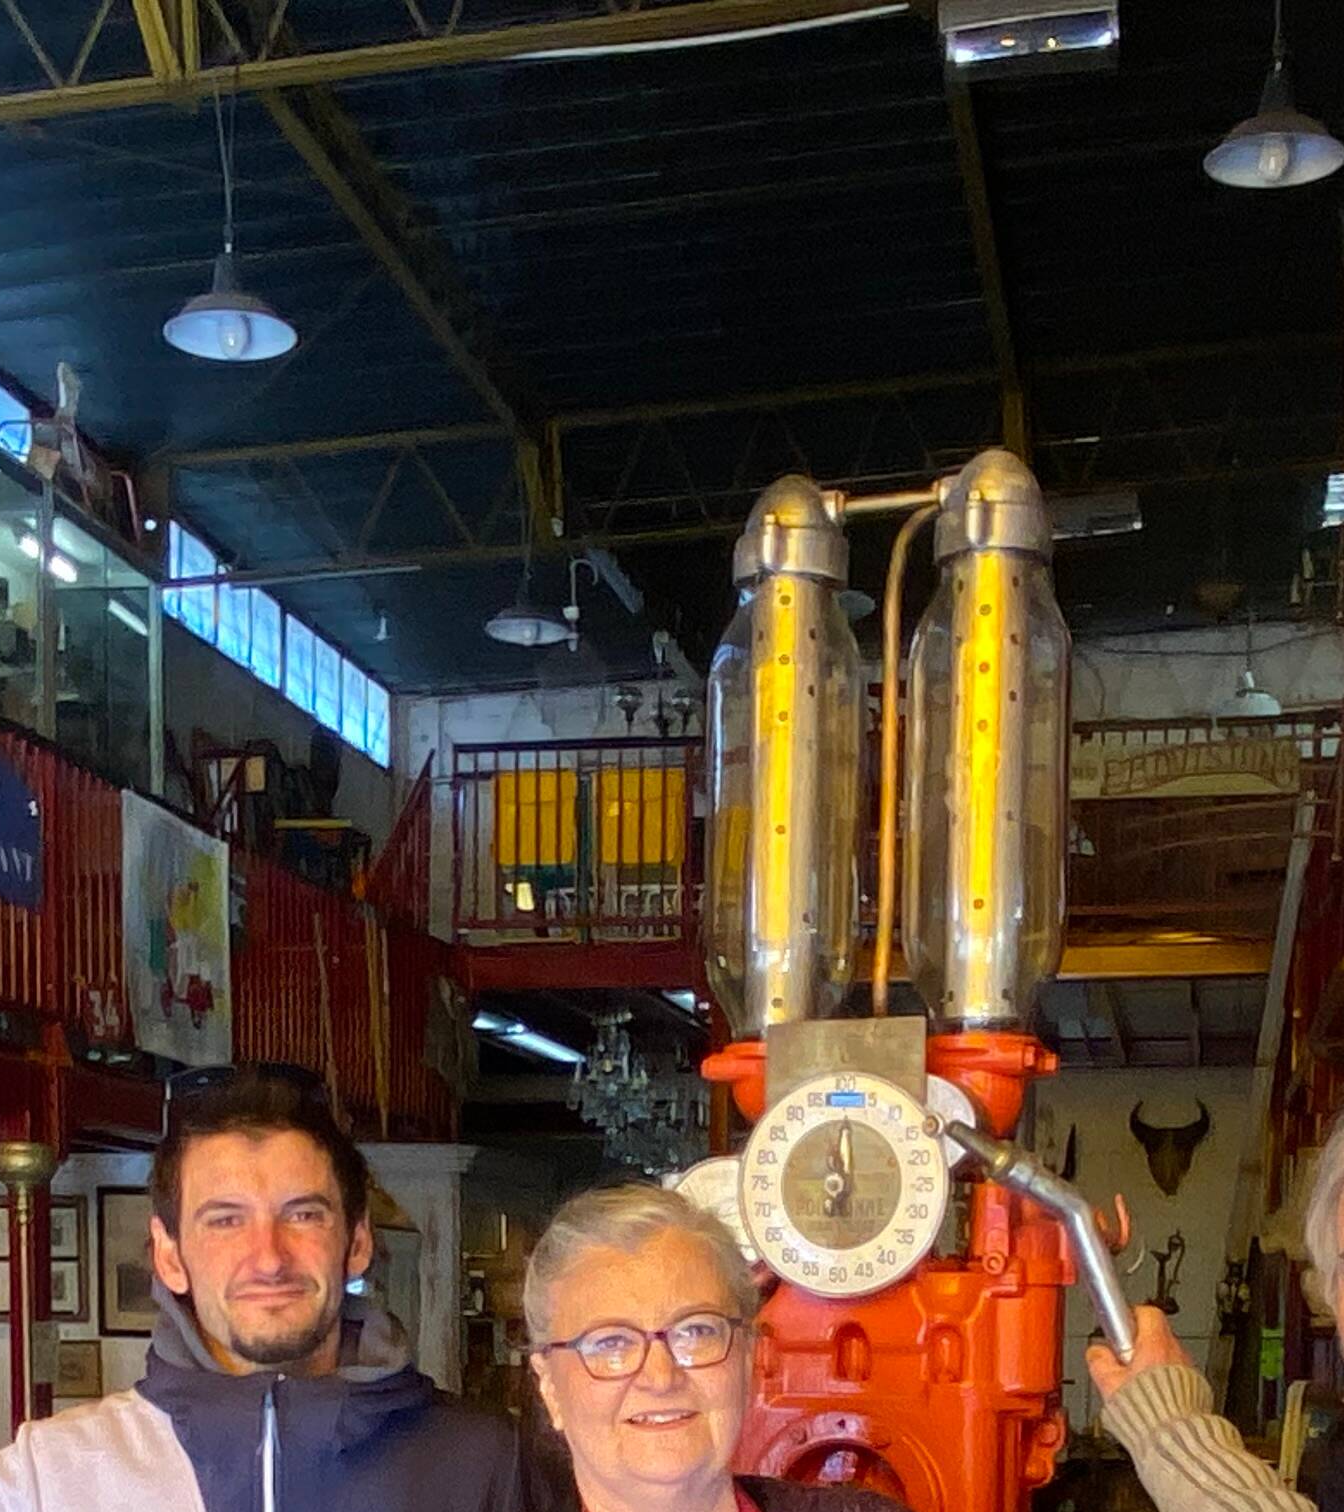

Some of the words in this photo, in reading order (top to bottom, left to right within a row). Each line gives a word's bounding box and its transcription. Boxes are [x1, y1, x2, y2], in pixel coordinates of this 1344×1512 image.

[911, 1151, 930, 1165] 20
[896, 1229, 914, 1244] 35
[877, 1250, 896, 1264] 40
[829, 1268, 847, 1282] 50
[855, 1263, 874, 1277] 45
